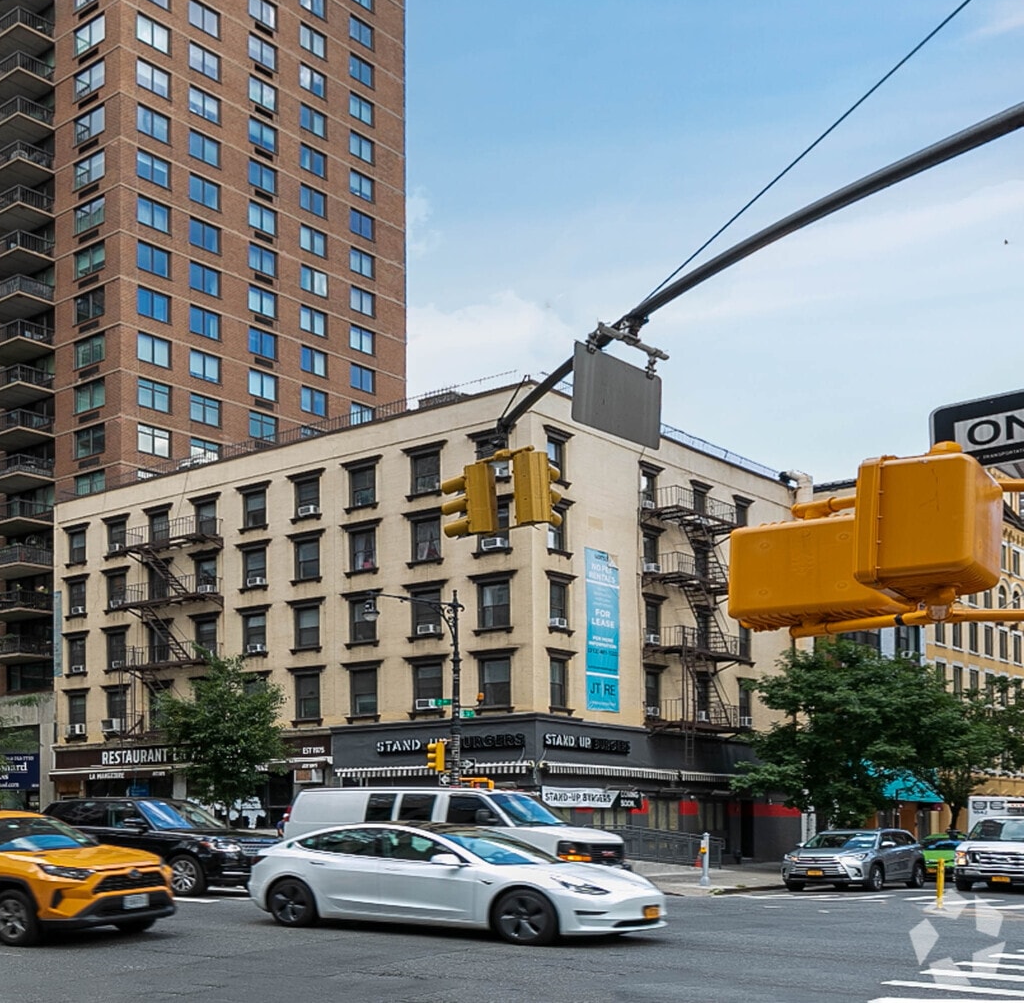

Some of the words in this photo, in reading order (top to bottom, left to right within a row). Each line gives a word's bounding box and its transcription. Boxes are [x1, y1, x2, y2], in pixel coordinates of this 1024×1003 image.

[594, 608, 611, 618] FOR
[591, 617, 615, 629] LEASE
[604, 684, 616, 696] RE
[376, 739, 421, 753] STAND
[462, 733, 526, 748] URGERS
[545, 733, 575, 747] STAND
[579, 737, 592, 748] UP
[101, 748, 168, 765] RESTAURANT
[302, 747, 312, 755] EST
[544, 792, 581, 802] STAND-UP
